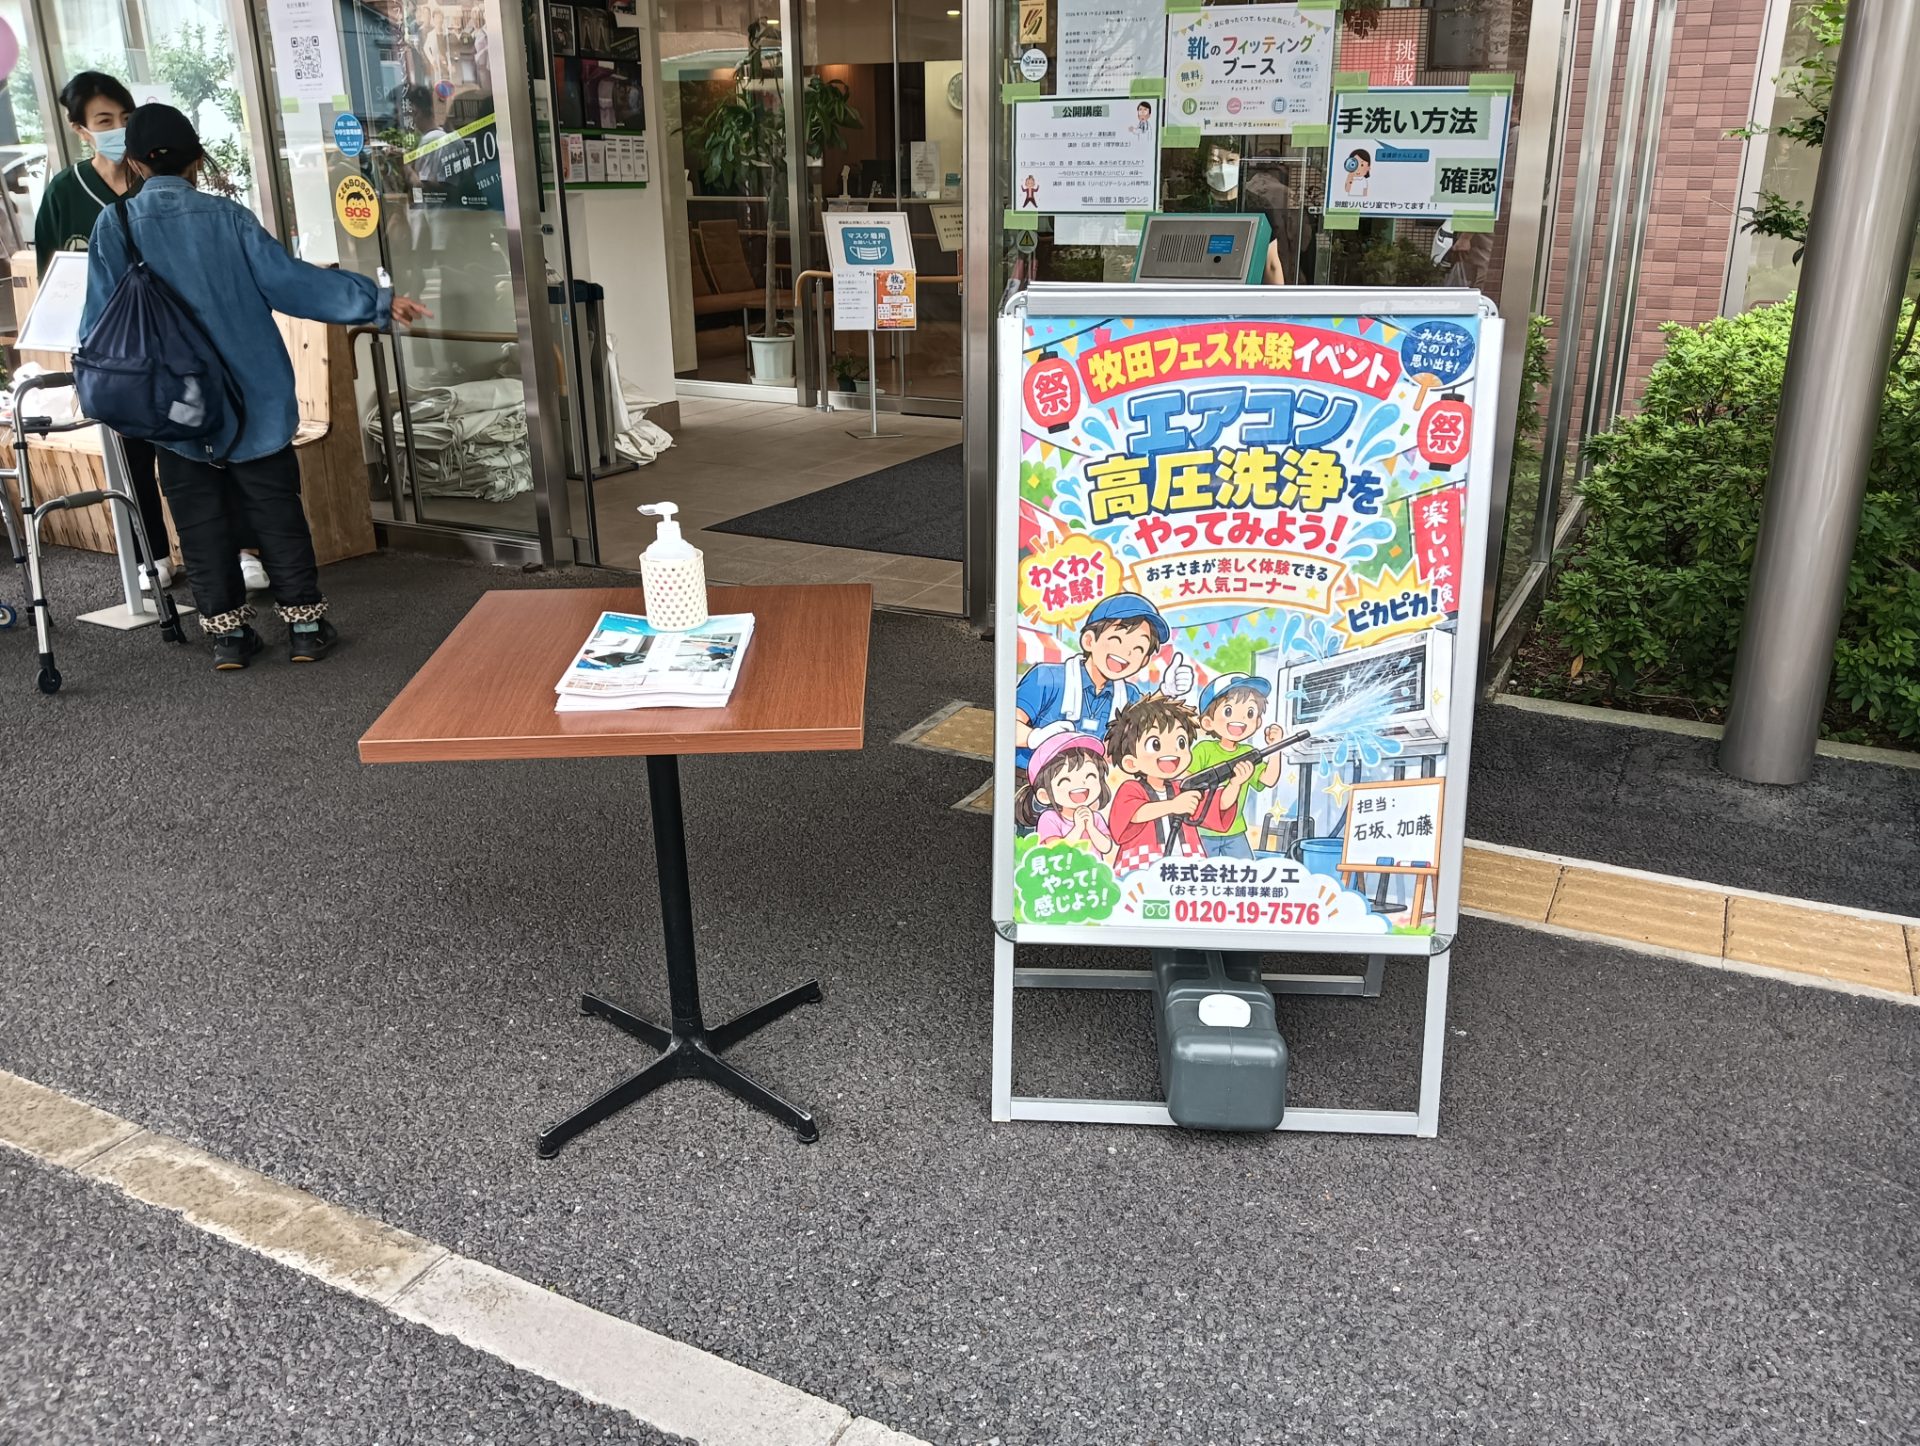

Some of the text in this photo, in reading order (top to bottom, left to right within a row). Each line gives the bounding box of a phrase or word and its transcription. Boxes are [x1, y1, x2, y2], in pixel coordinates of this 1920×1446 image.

[1187, 34, 1315, 60] 靴のフィッティング
[1223, 57, 1276, 76] ブース
[1392, 39, 1417, 86] 挑戦
[1180, 70, 1200, 82] 無料
[1062, 106, 1103, 118] 公開講座
[1337, 106, 1478, 134] 手洗い方法
[1439, 167, 1498, 195] 確認
[345, 207, 371, 218] SOS
[1334, 200, 1438, 211] 別館リハビリ室でやってます！！
[847, 232, 886, 240] マスク着用
[1416, 341, 1460, 357] たのしい
[1420, 328, 1465, 345] みんなで
[1087, 329, 1391, 393] 牧田フェス体験イベント
[1409, 353, 1460, 374] 思い出を！
[1034, 367, 1071, 414] 祭
[1127, 386, 1358, 455] エアコン
[1427, 411, 1462, 453] 祭
[1085, 446, 1384, 523] 高圧洗浄を
[1134, 510, 1348, 555] やってみよう！
[1028, 551, 1104, 587] わくわく
[1146, 557, 1328, 582] お子さまが楽しく体験できる
[1042, 574, 1104, 611] 体験！
[1179, 576, 1297, 597] 大人気コーナー
[1348, 587, 1439, 633] ピカピカ！
[1357, 796, 1395, 814] 担当：
[1353, 814, 1433, 841] 石坂、加藤
[1030, 852, 1073, 878] 見て！
[1160, 863, 1300, 884] 株式会社カノエ
[1042, 867, 1098, 894] やって！
[1169, 884, 1290, 899] （おそうじ本舗事業部）
[1034, 887, 1109, 918] 感じよう！
[1175, 899, 1320, 925] 0120-19-7576
